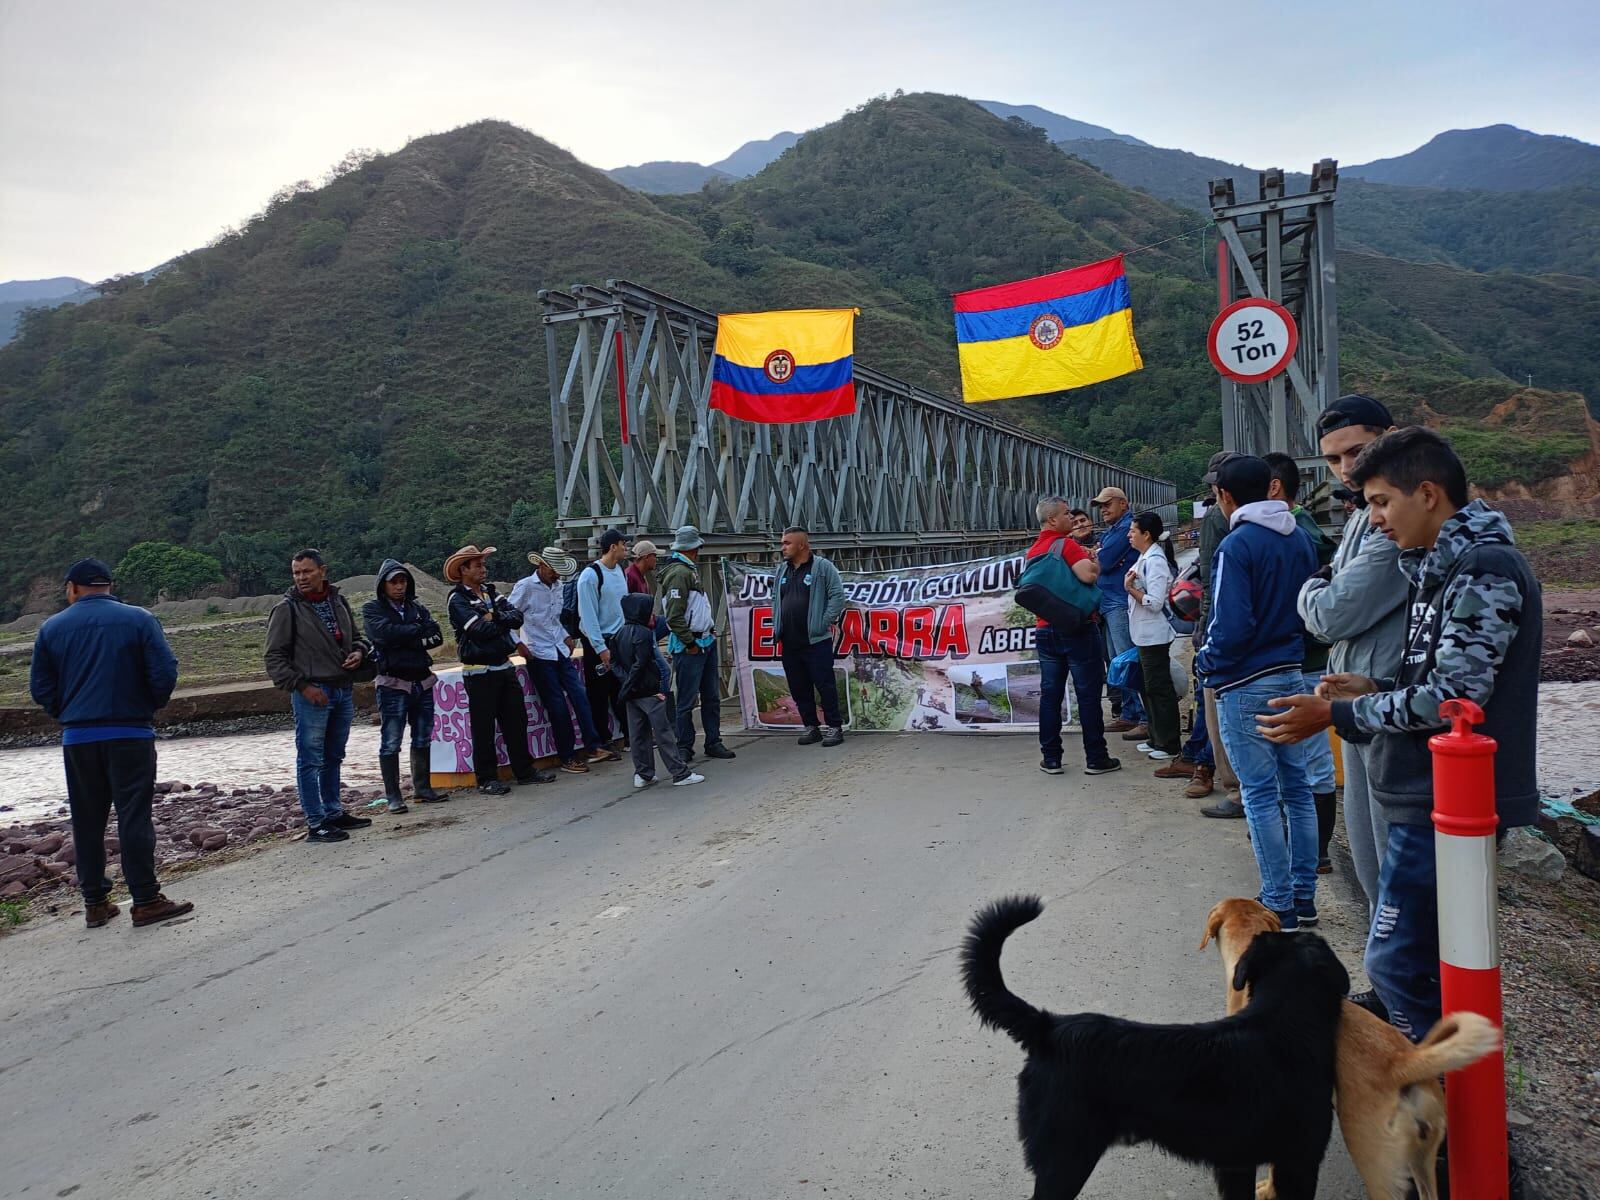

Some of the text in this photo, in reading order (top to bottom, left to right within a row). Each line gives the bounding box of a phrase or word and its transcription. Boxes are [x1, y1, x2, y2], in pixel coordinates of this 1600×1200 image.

[1237, 319, 1265, 341] 52
[1231, 342, 1277, 364] Ton
[919, 556, 1025, 601] COMUN
[978, 625, 1037, 655] ÁBRE
